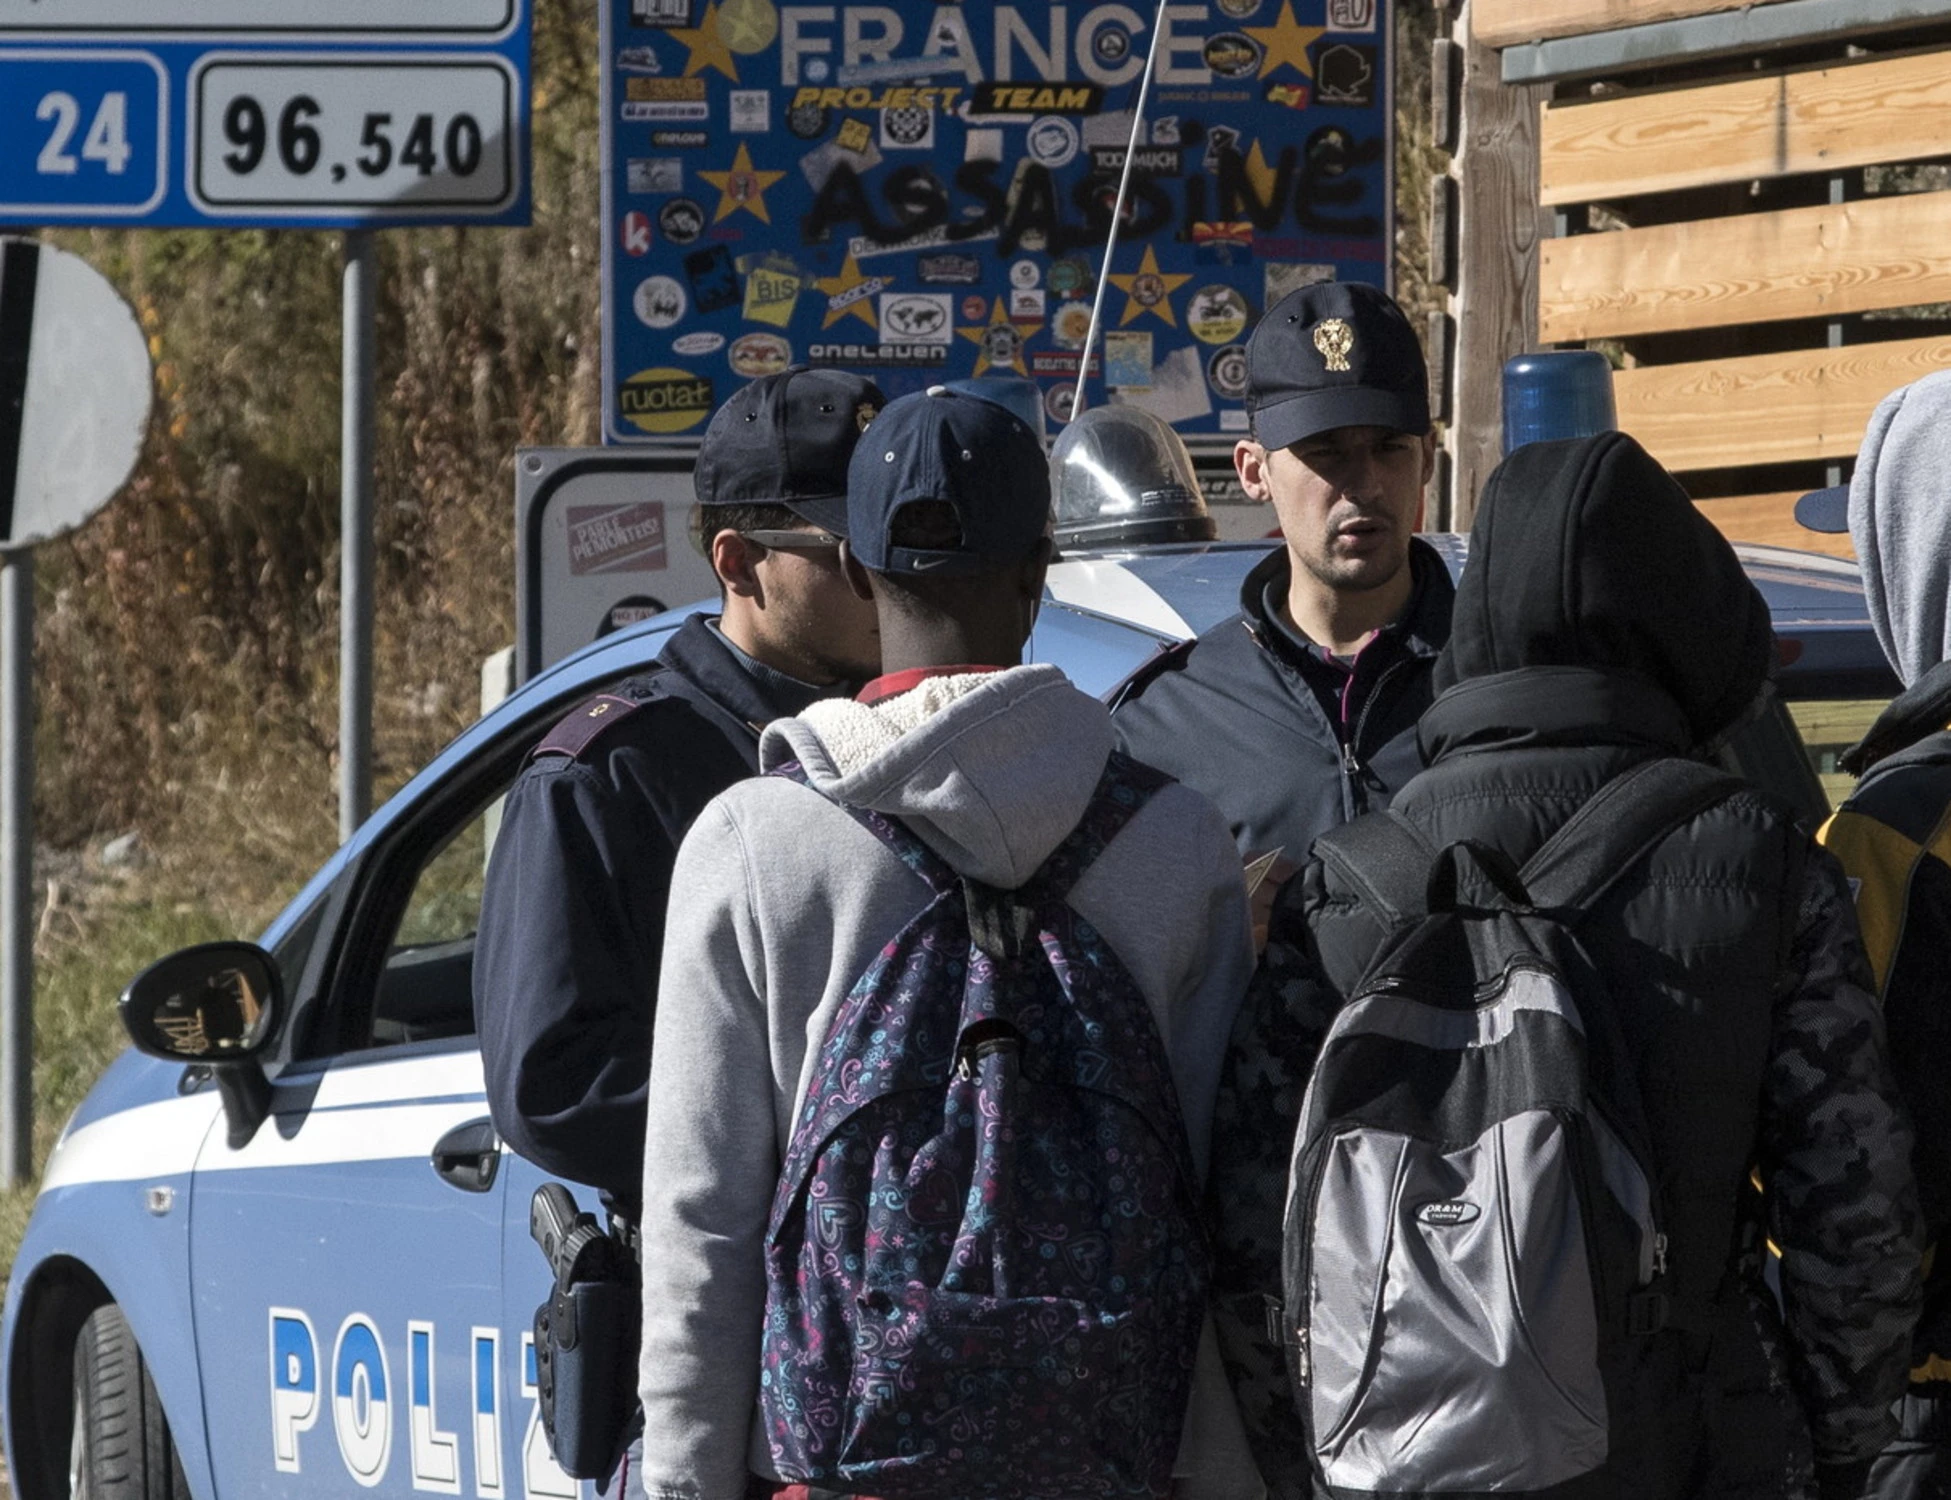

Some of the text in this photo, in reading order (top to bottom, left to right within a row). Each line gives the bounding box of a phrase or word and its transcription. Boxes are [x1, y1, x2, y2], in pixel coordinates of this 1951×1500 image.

[780, 4, 1212, 87] FRANCE
[35, 91, 132, 175] 24
[223, 95, 482, 183] 96,540
[793, 88, 1091, 110] PROJECT TEAM
